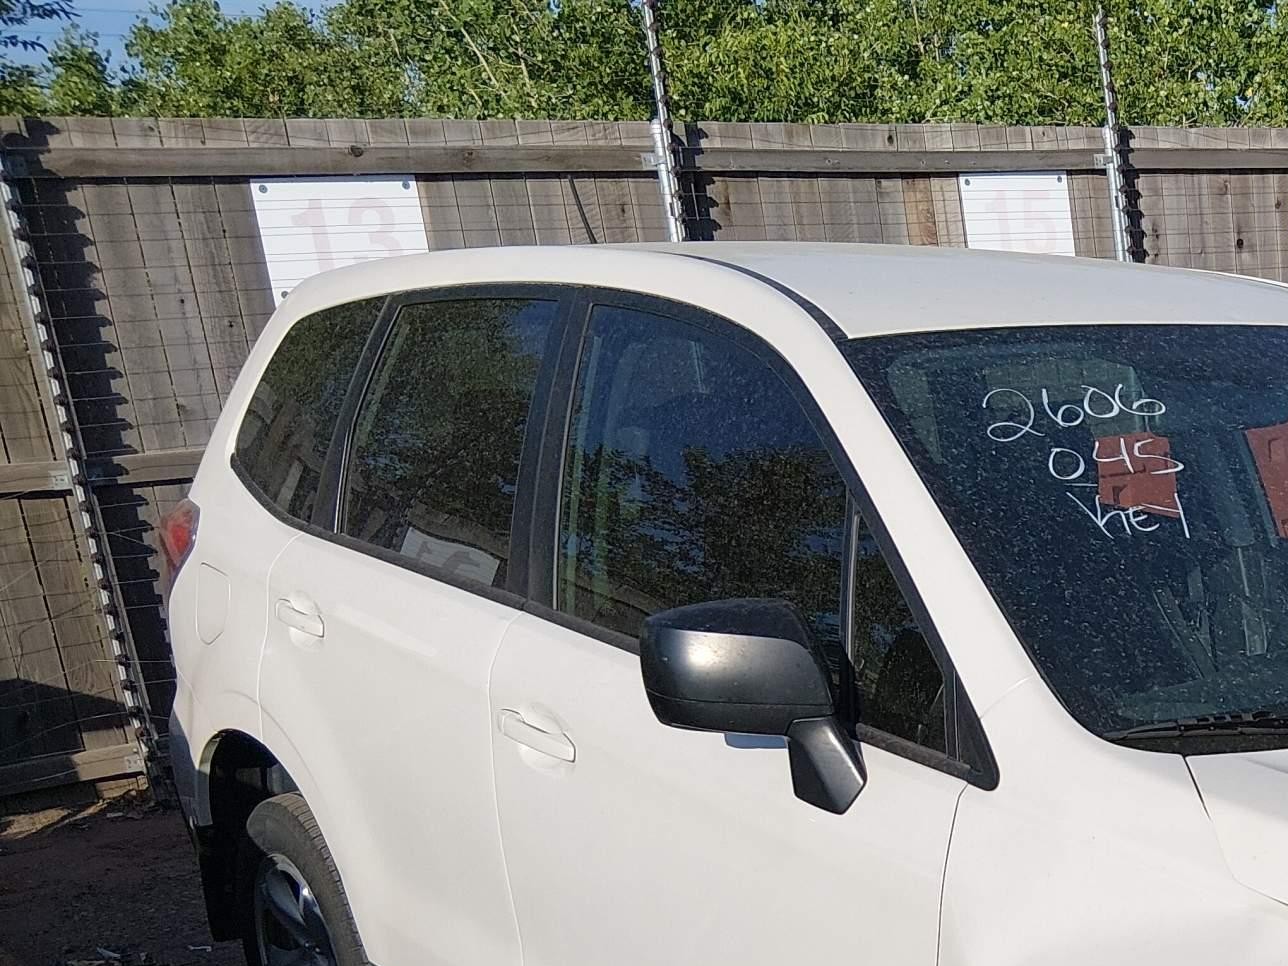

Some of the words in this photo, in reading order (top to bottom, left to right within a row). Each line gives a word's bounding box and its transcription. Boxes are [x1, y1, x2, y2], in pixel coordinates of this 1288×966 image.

[291, 198, 404, 272] 13
[983, 384, 1167, 442] 2606
[1048, 437, 1185, 480] 045
